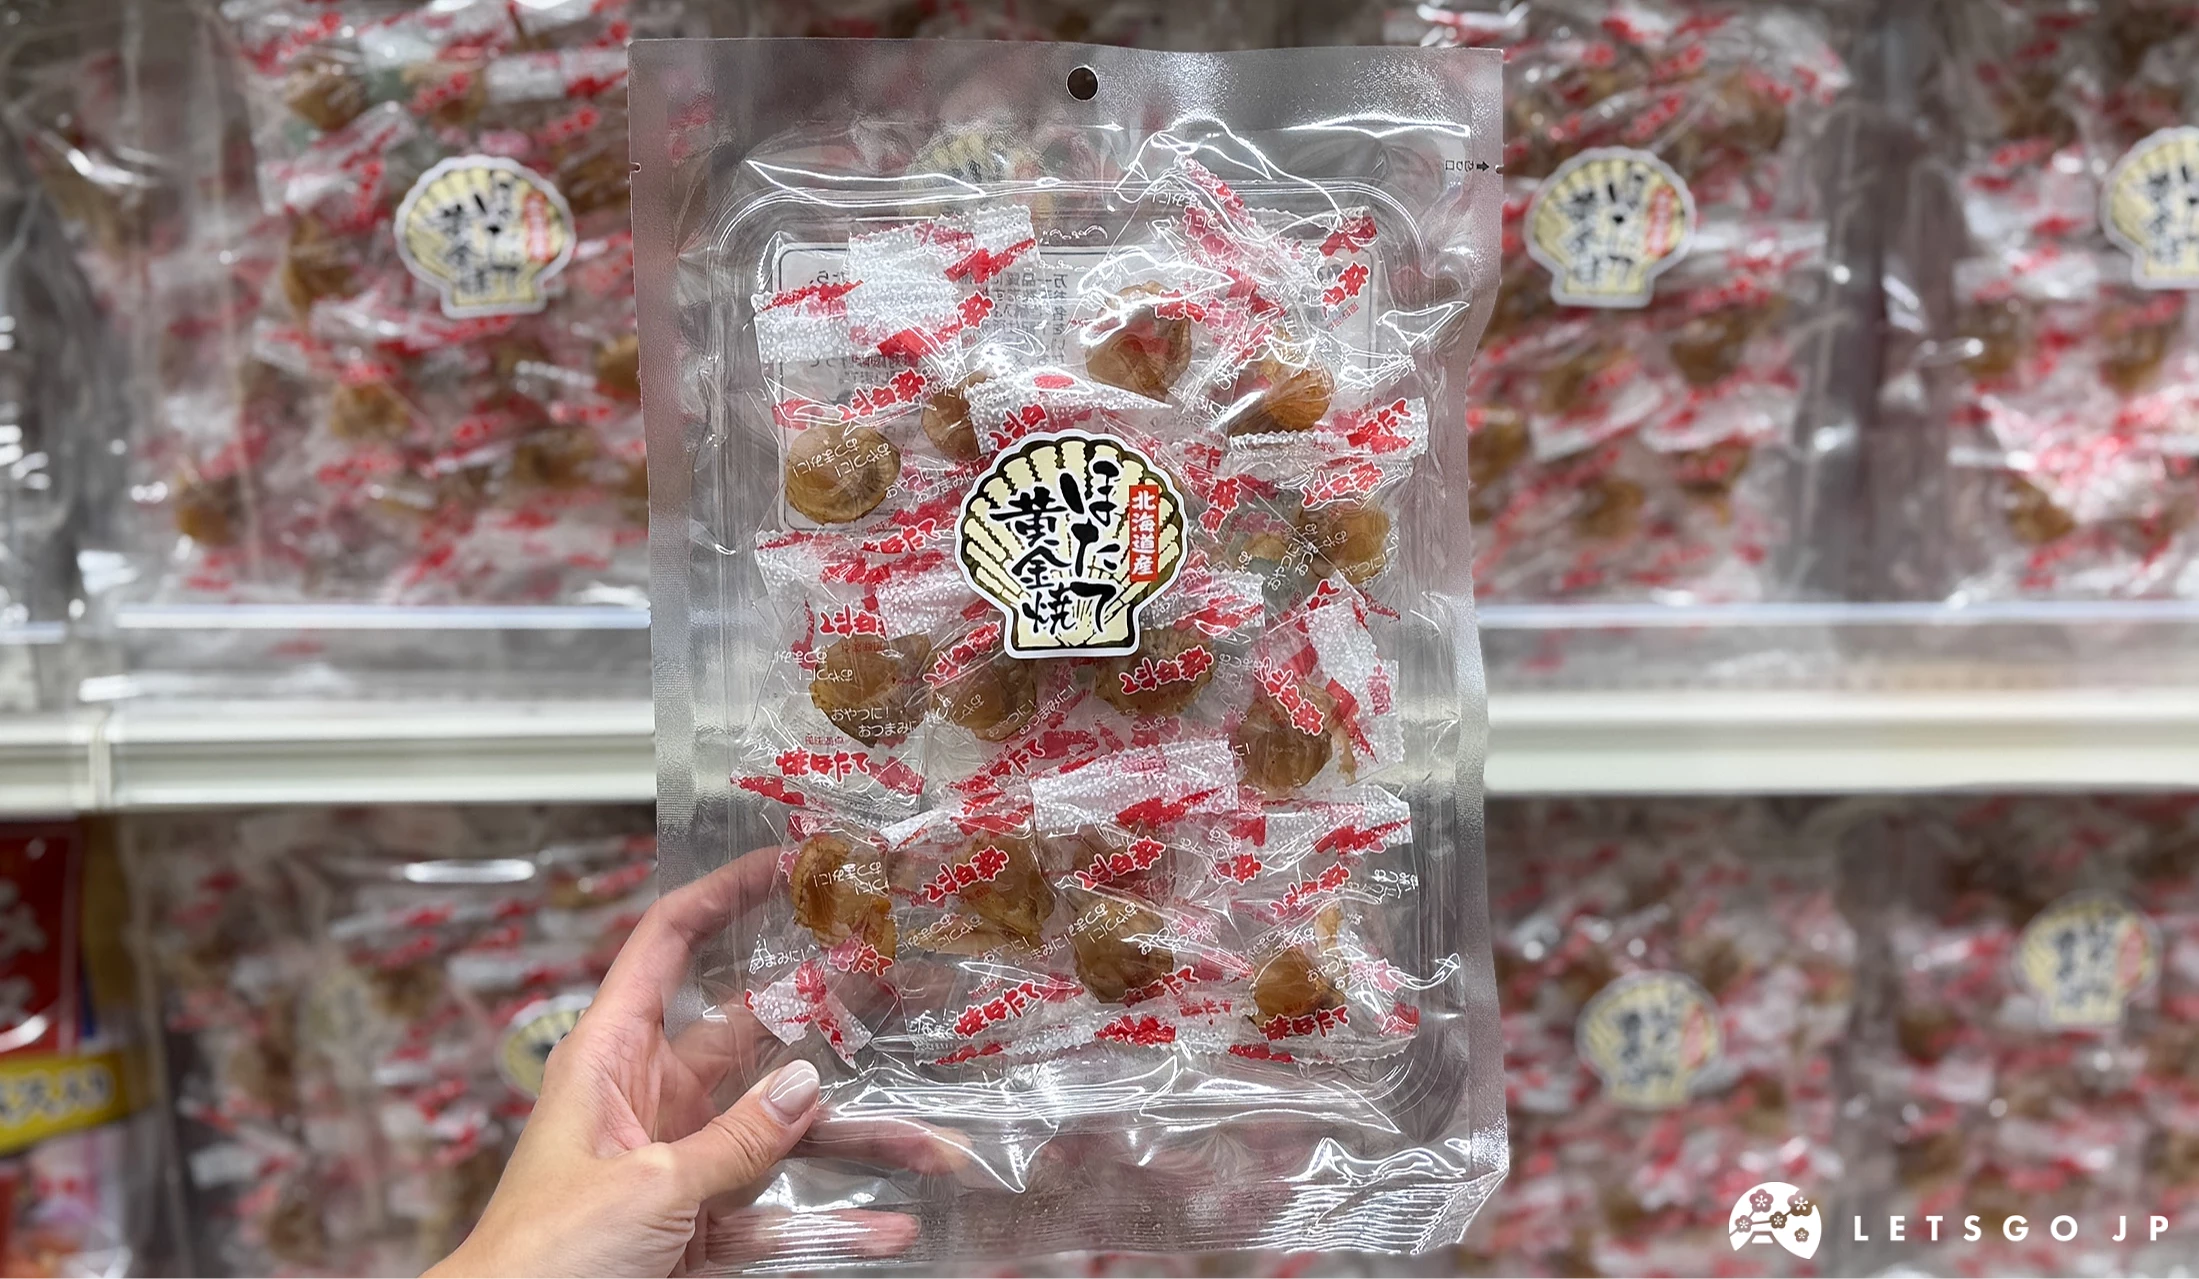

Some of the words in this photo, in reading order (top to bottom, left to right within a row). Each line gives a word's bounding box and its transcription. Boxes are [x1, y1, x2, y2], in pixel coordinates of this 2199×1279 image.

[989, 486, 1076, 635] 黄金焼
[1059, 460, 1121, 632] ほたて
[1131, 490, 1156, 576] 北海道産
[831, 707, 889, 721] おやつに!
[776, 747, 871, 783] 焼ほたて
[953, 979, 1042, 1038] 焼ほたて
